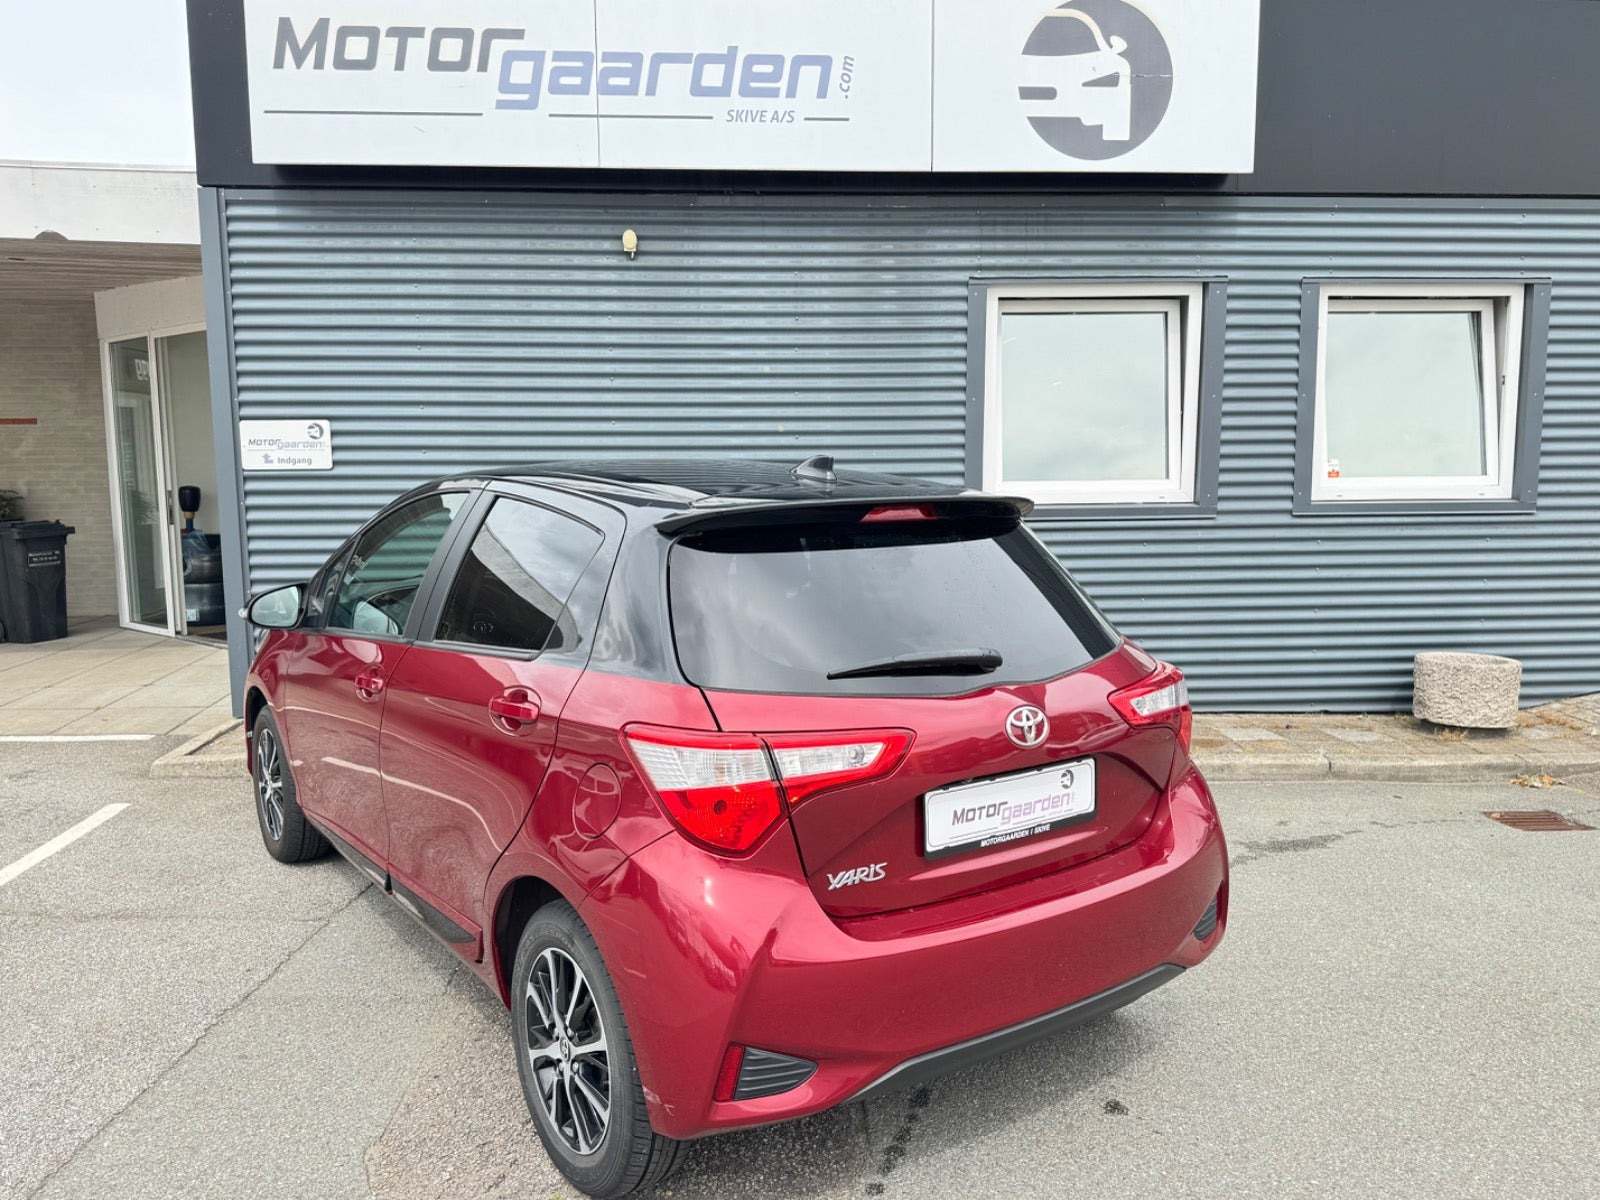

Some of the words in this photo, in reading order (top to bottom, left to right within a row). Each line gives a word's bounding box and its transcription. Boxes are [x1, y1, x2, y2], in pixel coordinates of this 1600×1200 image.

[839, 55, 855, 99] .com
[726, 109, 768, 123] SKIVE
[770, 110, 796, 123] A/S
[277, 456, 313, 466] Indgang
[980, 829, 1029, 847] MOTORGAARDEN
[1034, 823, 1051, 834] SKIVE
[826, 862, 888, 890] YARIS
